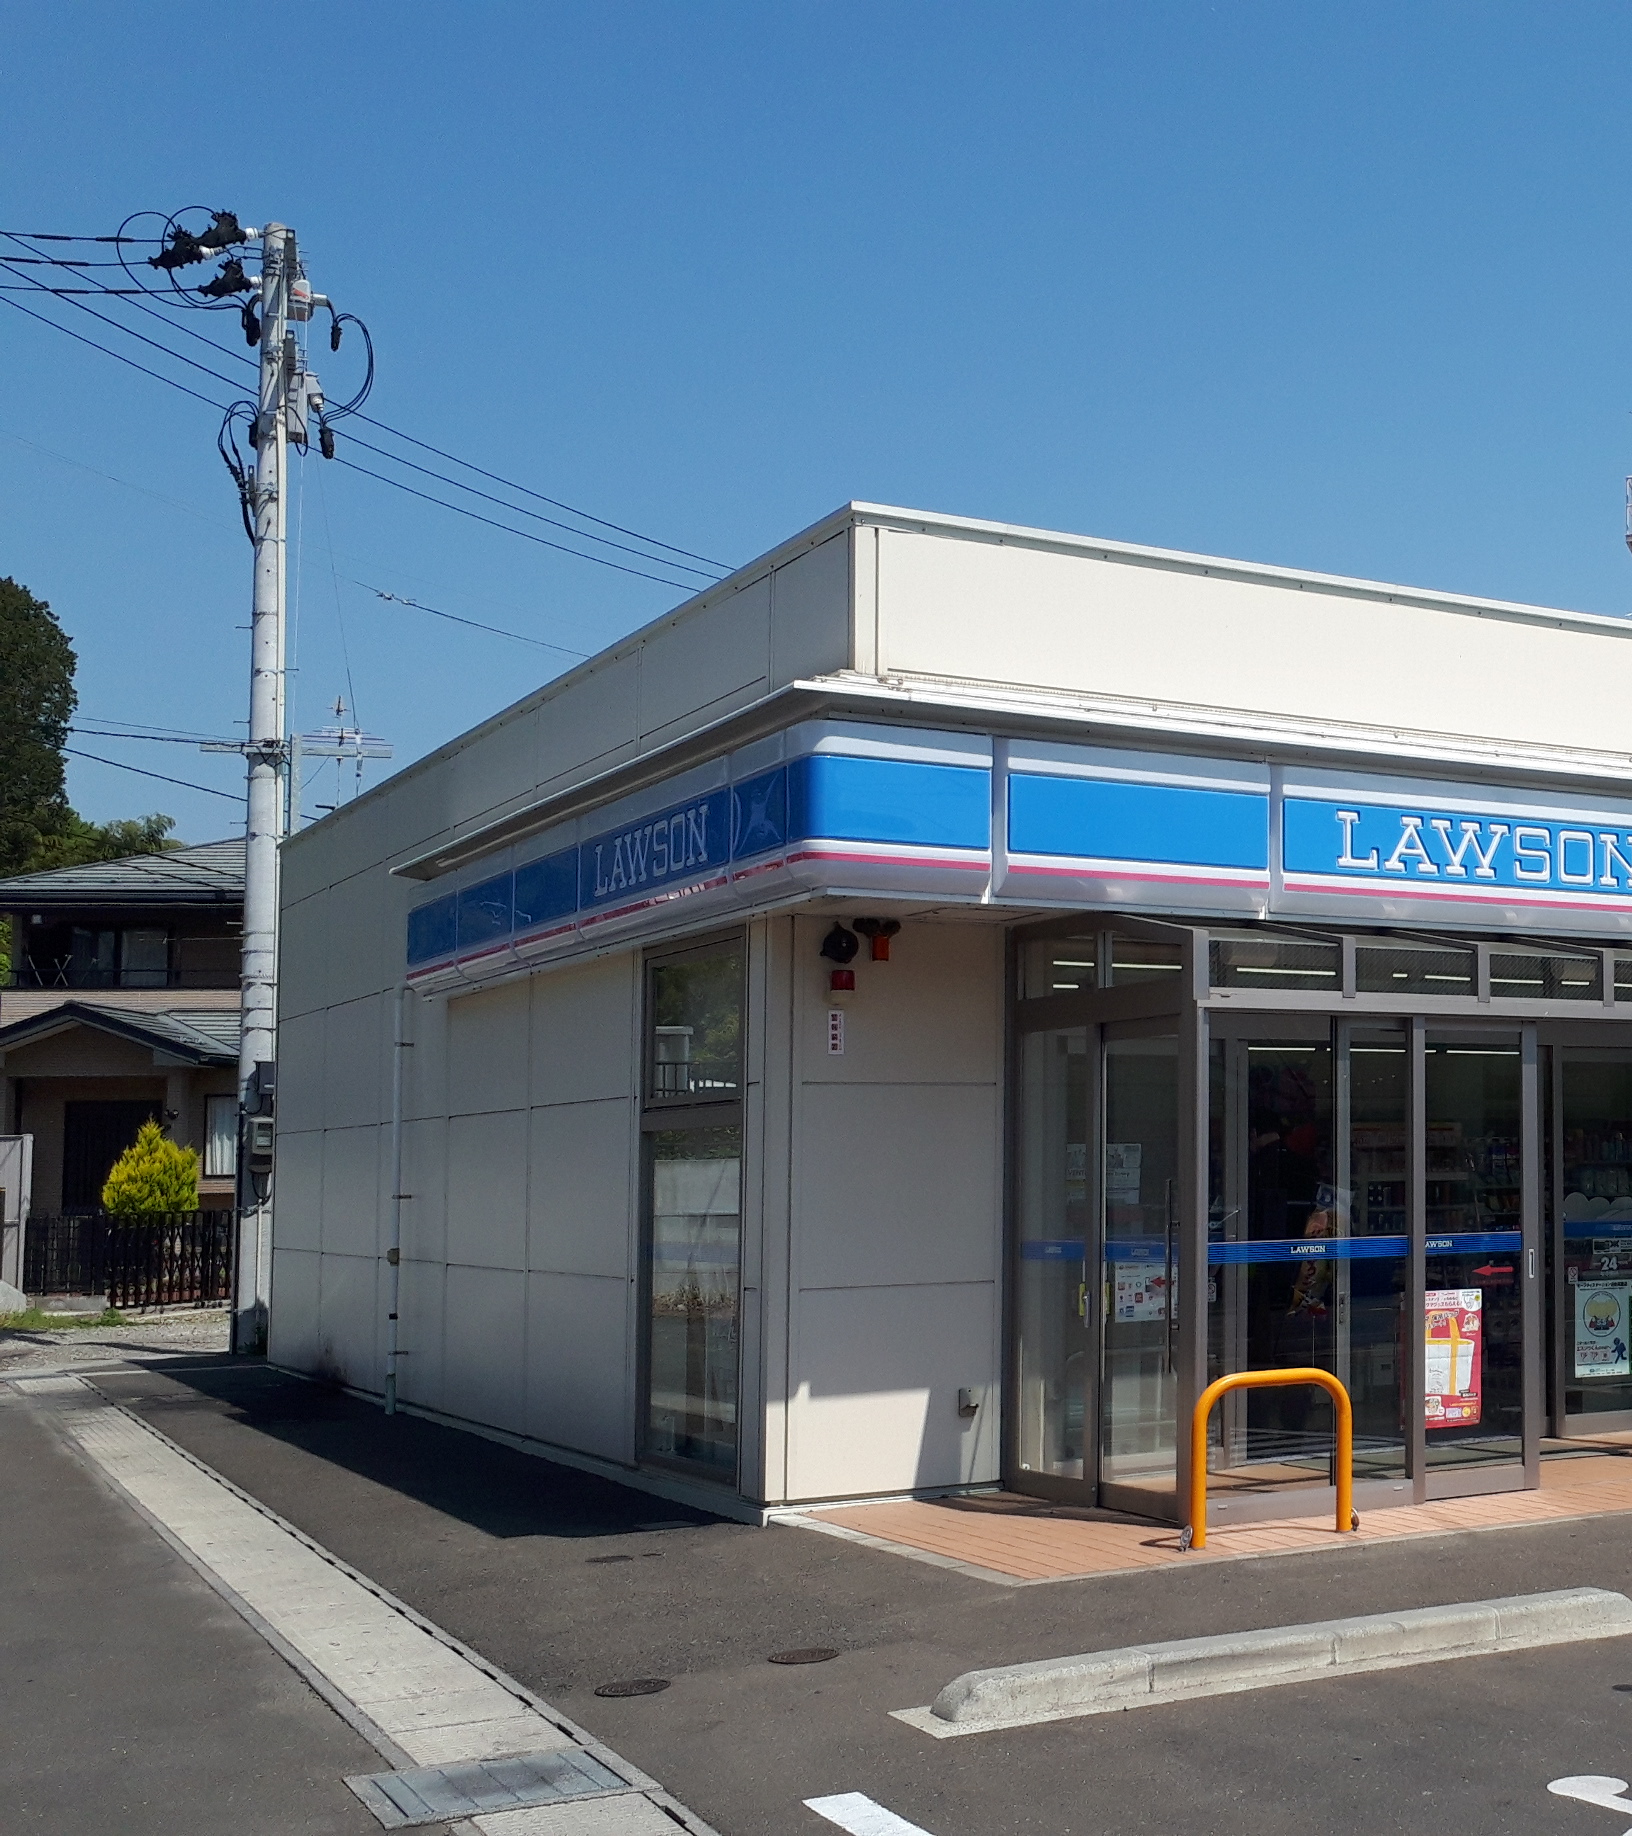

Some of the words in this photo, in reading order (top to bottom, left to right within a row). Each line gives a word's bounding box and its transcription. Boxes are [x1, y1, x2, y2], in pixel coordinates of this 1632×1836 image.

[594, 801, 709, 898] LAWSON
[1290, 1245, 1326, 1254] LAWSON
[1601, 1256, 1618, 1270] 24
